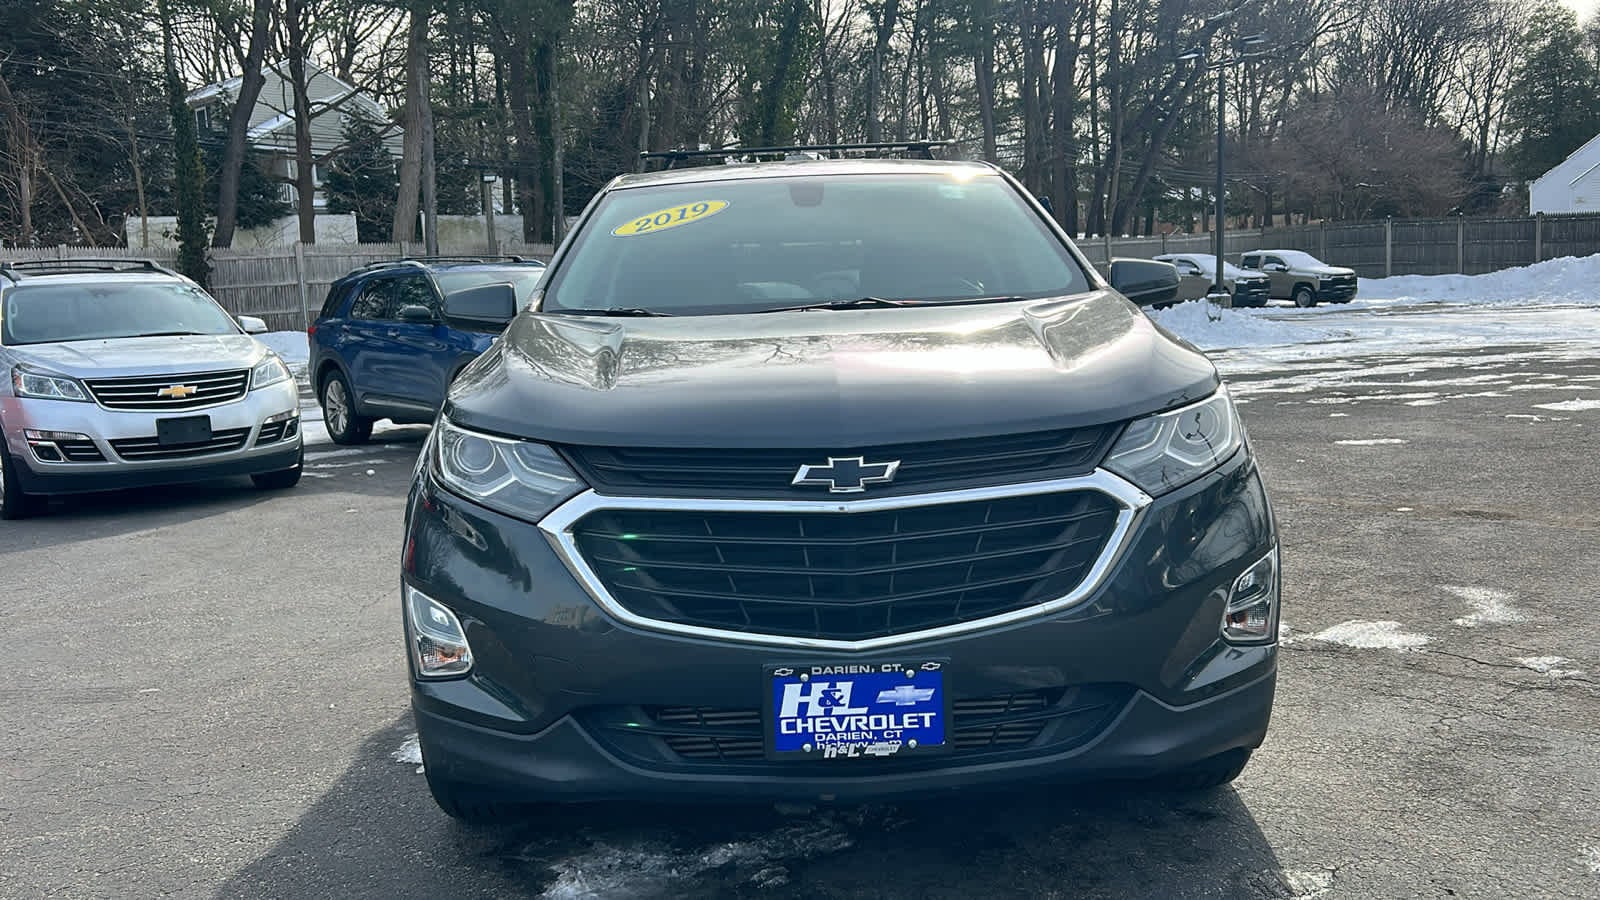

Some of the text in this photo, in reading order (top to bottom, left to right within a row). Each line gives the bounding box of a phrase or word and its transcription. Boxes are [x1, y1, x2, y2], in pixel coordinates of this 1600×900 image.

[635, 203, 709, 232] 2019
[811, 664, 904, 675] DARIEN, CT.
[779, 681, 869, 718] H&L
[780, 712, 936, 734] CHEVROLET
[814, 730, 903, 742] DARIEN, CT
